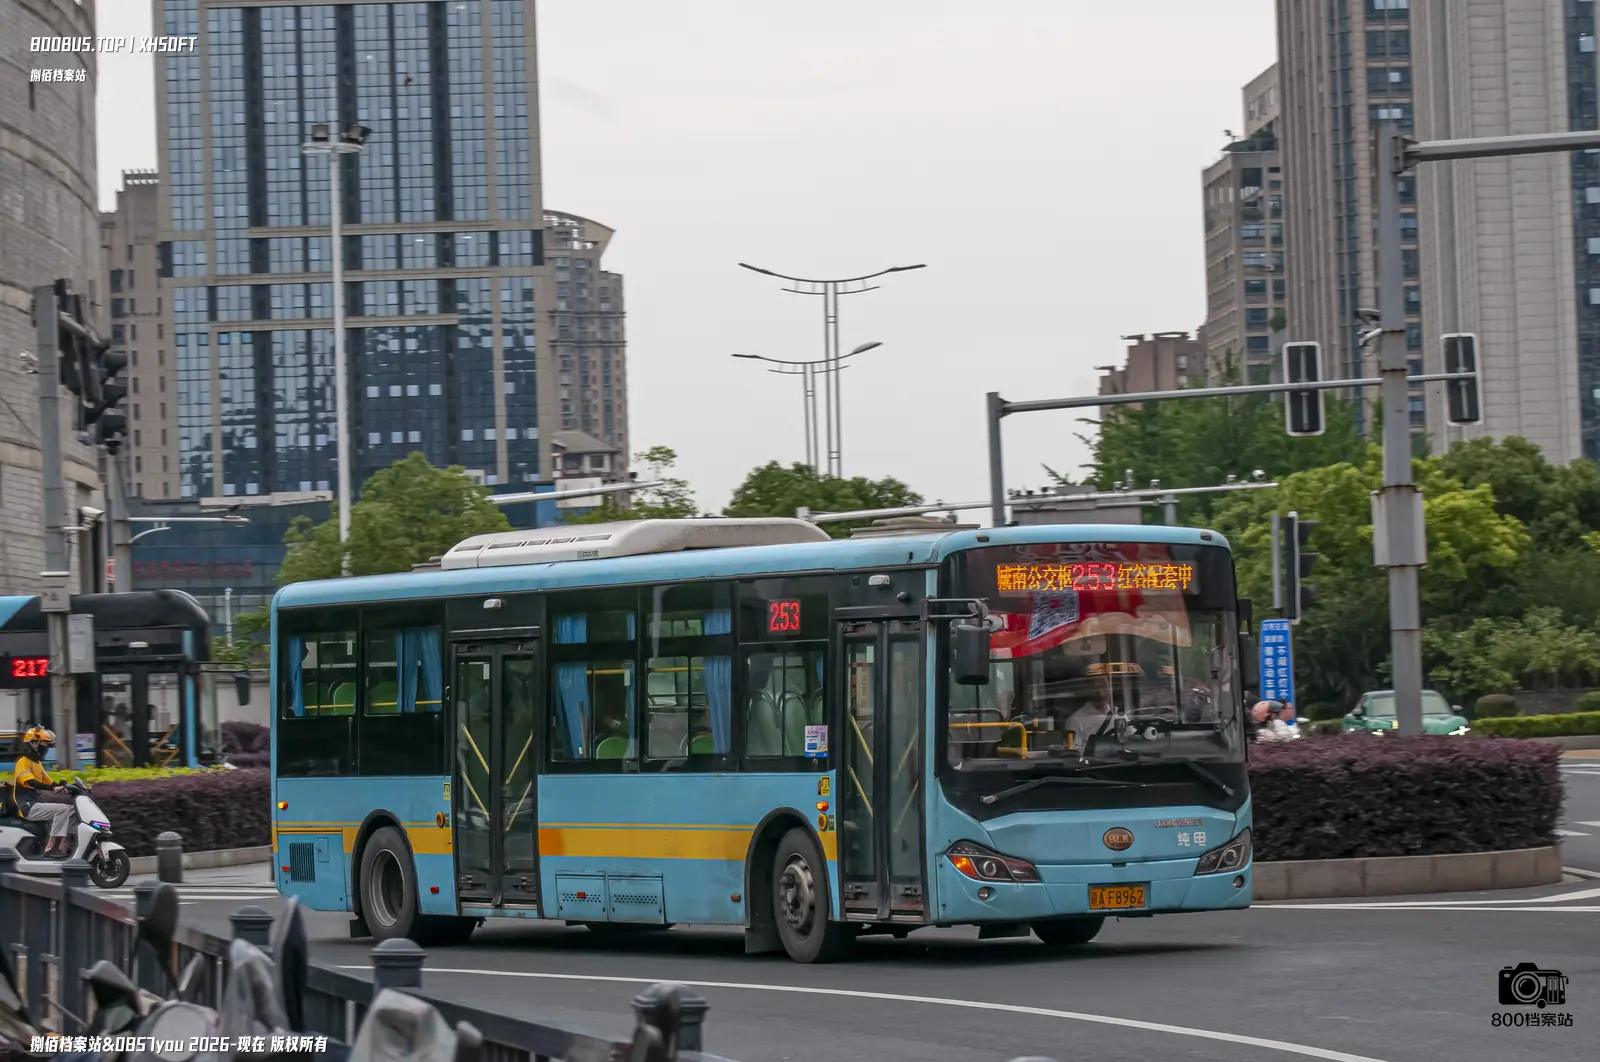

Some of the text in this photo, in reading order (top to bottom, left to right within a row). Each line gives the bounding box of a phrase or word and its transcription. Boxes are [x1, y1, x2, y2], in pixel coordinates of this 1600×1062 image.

[1072, 564, 1115, 591] 253
[769, 601, 800, 631] 253
[12, 658, 49, 677] 217
[1108, 834, 1129, 844] BLK
[1176, 831, 1206, 847] 纯电
